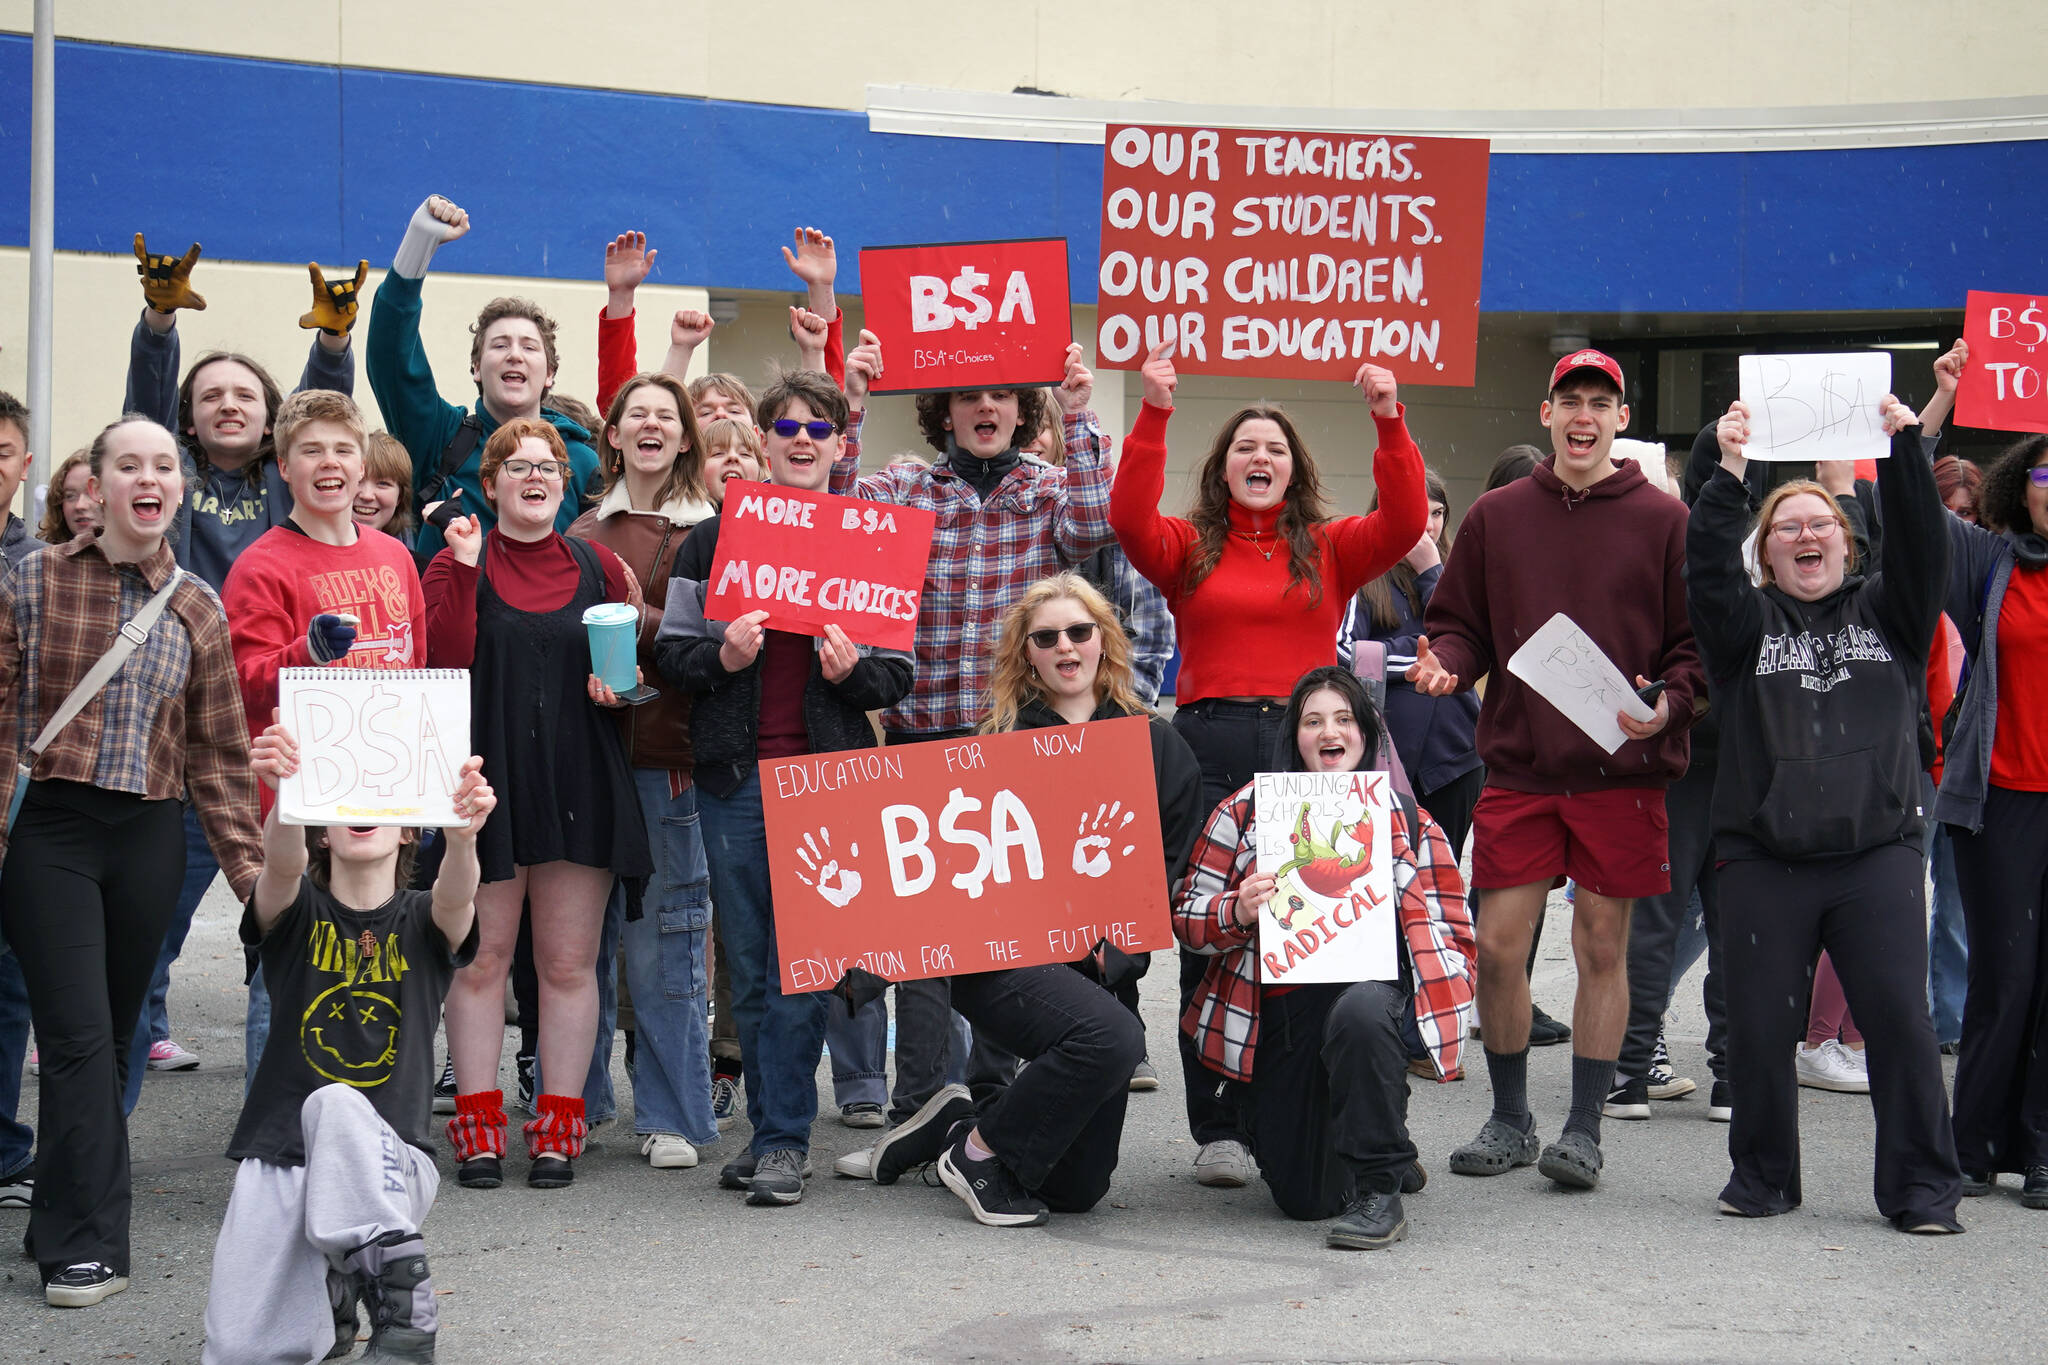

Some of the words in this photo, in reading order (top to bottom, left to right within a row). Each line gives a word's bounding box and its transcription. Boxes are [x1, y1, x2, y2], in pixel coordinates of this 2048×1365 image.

[1110, 127, 1220, 181] OUR
[1235, 136, 1423, 181] TEACHERS.
[1106, 187, 1216, 240] OUR
[1231, 192, 1443, 246] STUDENTS.
[1099, 250, 1210, 304] OUR
[1222, 252, 1429, 307] CHILDREN.
[1099, 311, 1207, 363] OUR
[1221, 316, 1445, 371] EDUCATION.
[1989, 299, 2048, 352] B$
[1984, 362, 2040, 400] TO
[735, 495, 817, 529] MORE
[309, 568, 386, 609] ROCK
[715, 559, 817, 607] MORE
[817, 577, 918, 621] CHOICES
[1755, 630, 1832, 676] ATLANC
[775, 754, 903, 799] EDUCATION
[944, 742, 986, 773] FOR
[1033, 728, 1085, 757] NOW
[1260, 774, 1349, 798] FUNDING
[1347, 774, 1383, 807] AK
[921, 944, 955, 974] FOR
[985, 940, 1022, 963] THE
[1263, 884, 1387, 979] RADICAL
